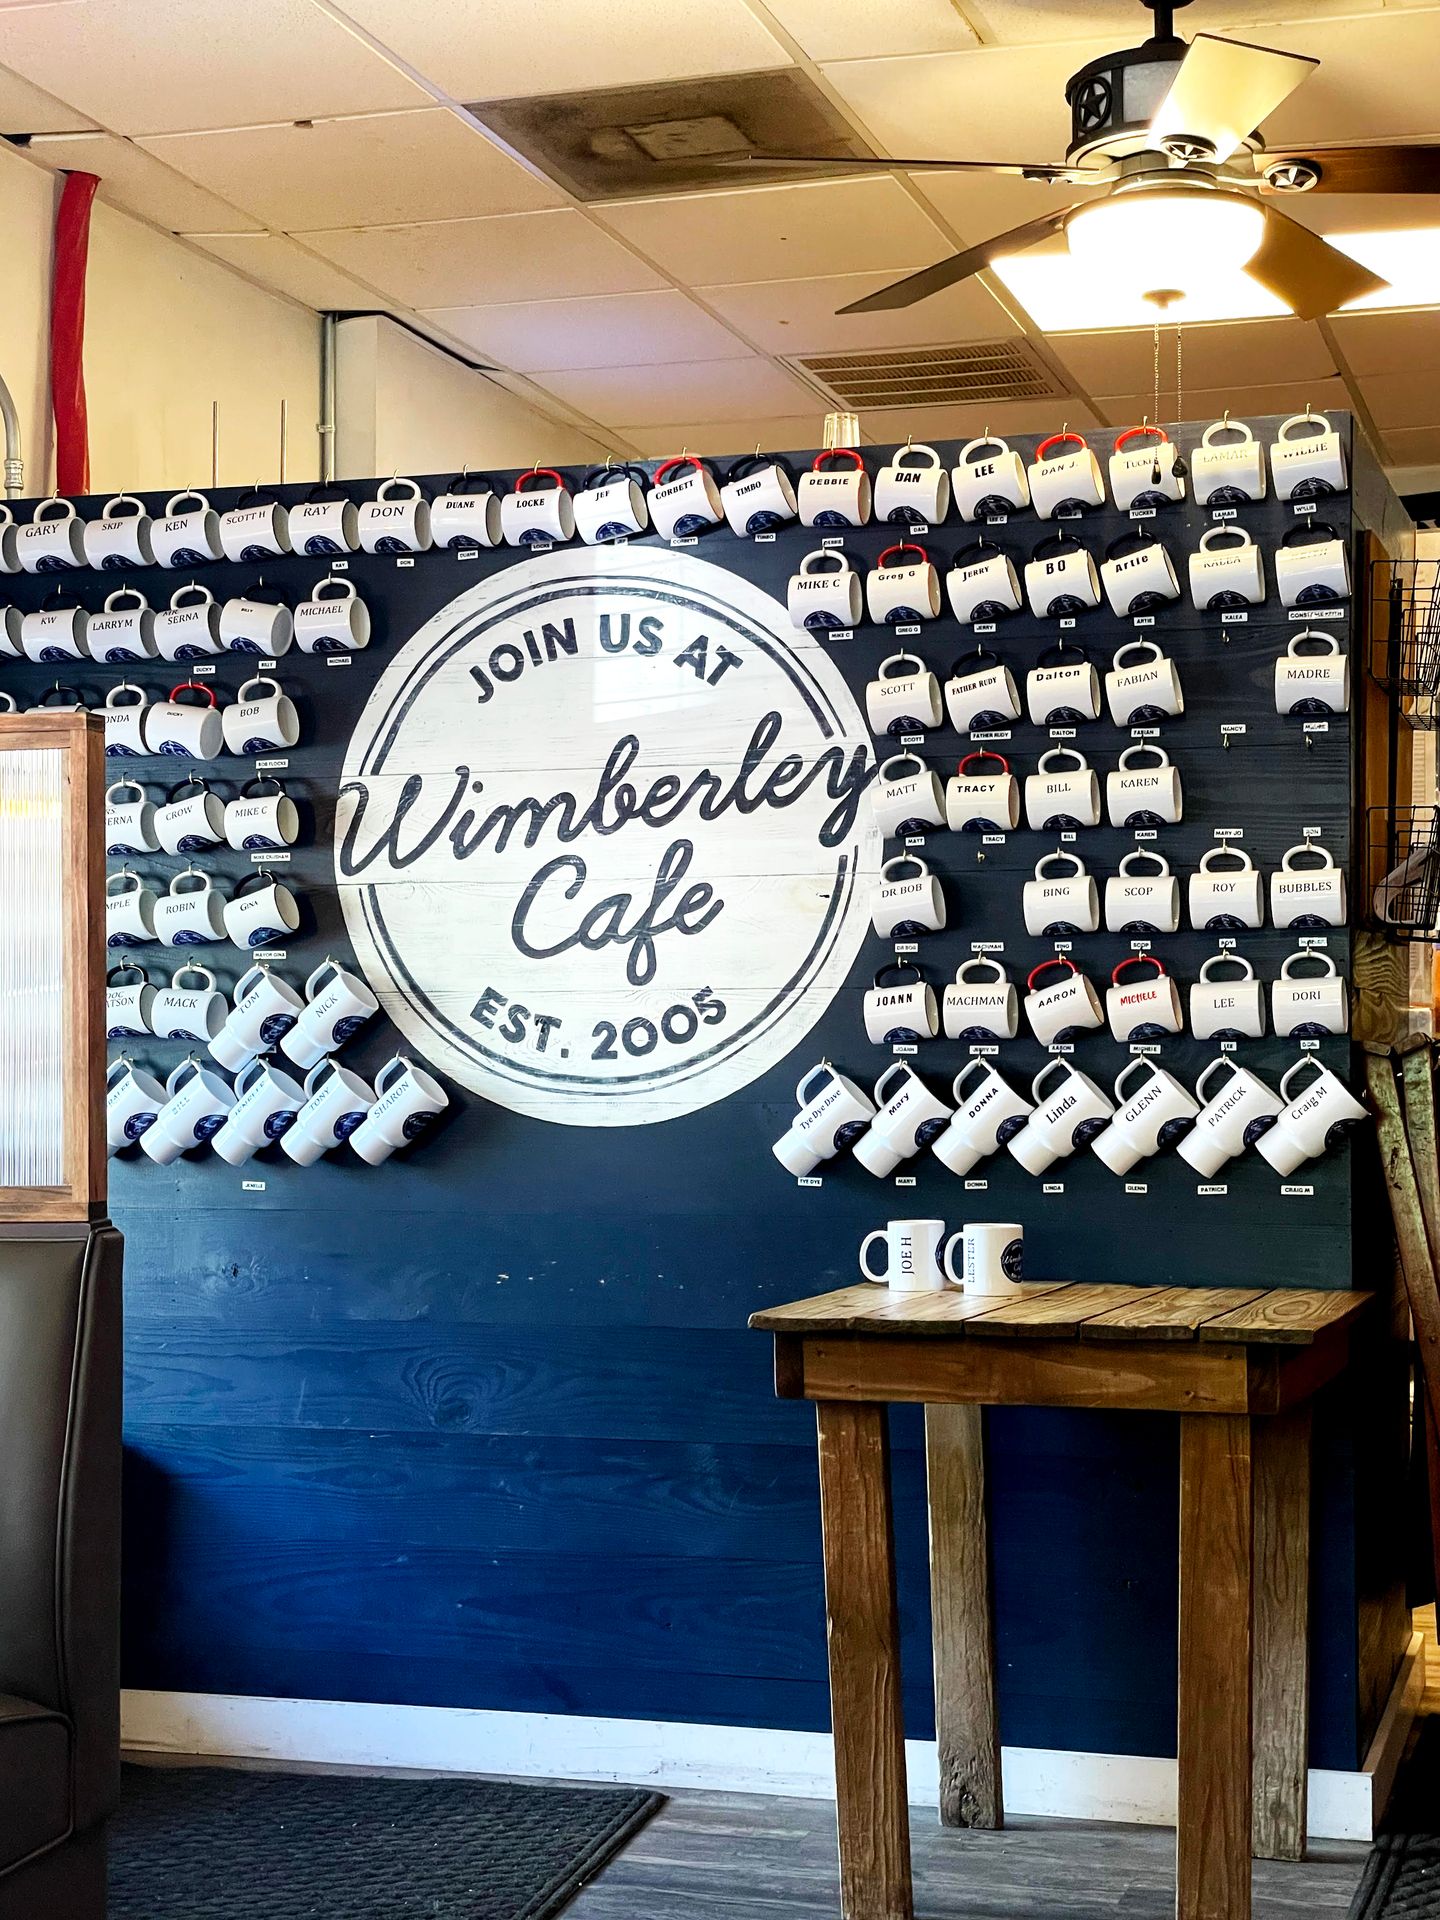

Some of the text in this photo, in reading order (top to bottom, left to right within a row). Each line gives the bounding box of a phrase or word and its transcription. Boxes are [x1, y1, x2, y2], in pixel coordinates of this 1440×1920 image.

[894, 472, 921, 483] DAN
[974, 463, 995, 478] LEE
[1041, 465, 1065, 477] DAN
[595, 490, 610, 501] JEF
[655, 479, 694, 500] CORBETT
[736, 481, 761, 497] TIMBO
[446, 501, 475, 509] DUANE
[516, 498, 545, 508] LOCKE
[303, 505, 331, 517] RAY
[370, 506, 405, 518] DON
[226, 512, 257, 525] SCOTT
[25, 523, 59, 537] GARY
[102, 522, 123, 531] SKIP
[165, 520, 188, 532] KEN
[1046, 560, 1066, 575] BO
[1115, 555, 1149, 572] Artie
[878, 573, 904, 581] Greg
[962, 566, 990, 581] JERRY
[797, 579, 840, 590] MIKE C
[300, 605, 343, 616] MICHAEL
[93, 619, 133, 630] LARRY M
[168, 612, 198, 625] SERNA
[470, 612, 744, 704] JOIN US AT
[1036, 670, 1081, 681] Dalton
[1117, 671, 1158, 687] FABIAN
[1287, 669, 1330, 679] MADRE
[880, 682, 916, 696] SCOTT
[952, 677, 997, 696] FATHER RUDY
[240, 707, 260, 718] BOB
[956, 785, 996, 793] TRACY
[1046, 783, 1071, 794] BILL
[1120, 777, 1159, 788] KAREN
[339, 711, 877, 877] Wimberley
[886, 783, 917, 798] MATT
[165, 805, 193, 821] CROW
[235, 806, 268, 818] MIKE C
[882, 883, 923, 898] DR BOB
[1043, 887, 1070, 897] BING
[1124, 887, 1153, 897] SCOP
[1212, 883, 1236, 893] ROY
[1279, 881, 1332, 894] BUBBLES
[166, 902, 196, 914] ROBIN
[511, 839, 724, 986] Cafe
[238, 992, 260, 1014] TOM
[877, 993, 913, 1007] JOANN
[947, 996, 1005, 1006] MACHMAN
[1038, 988, 1076, 1008] AARON
[1292, 991, 1321, 1001] DORI
[164, 998, 199, 1009] MACK
[315, 993, 338, 1018] NICK
[1213, 998, 1235, 1009] LEE
[469, 986, 727, 1061] EST. 2005
[308, 1087, 332, 1112] TONY
[373, 1080, 410, 1119] SHARON
[888, 1093, 910, 1115] Mary
[968, 1087, 999, 1119] DONNA
[1125, 1086, 1162, 1123] GLENN
[1291, 1086, 1327, 1121] Craig M
[800, 1089, 842, 1130] Tye Dye Dave
[1045, 1094, 1077, 1125] Linda
[1207, 1087, 1247, 1127] PATRICK
[901, 1237, 914, 1274] JOE H
[967, 1238, 975, 1283] LESTER
